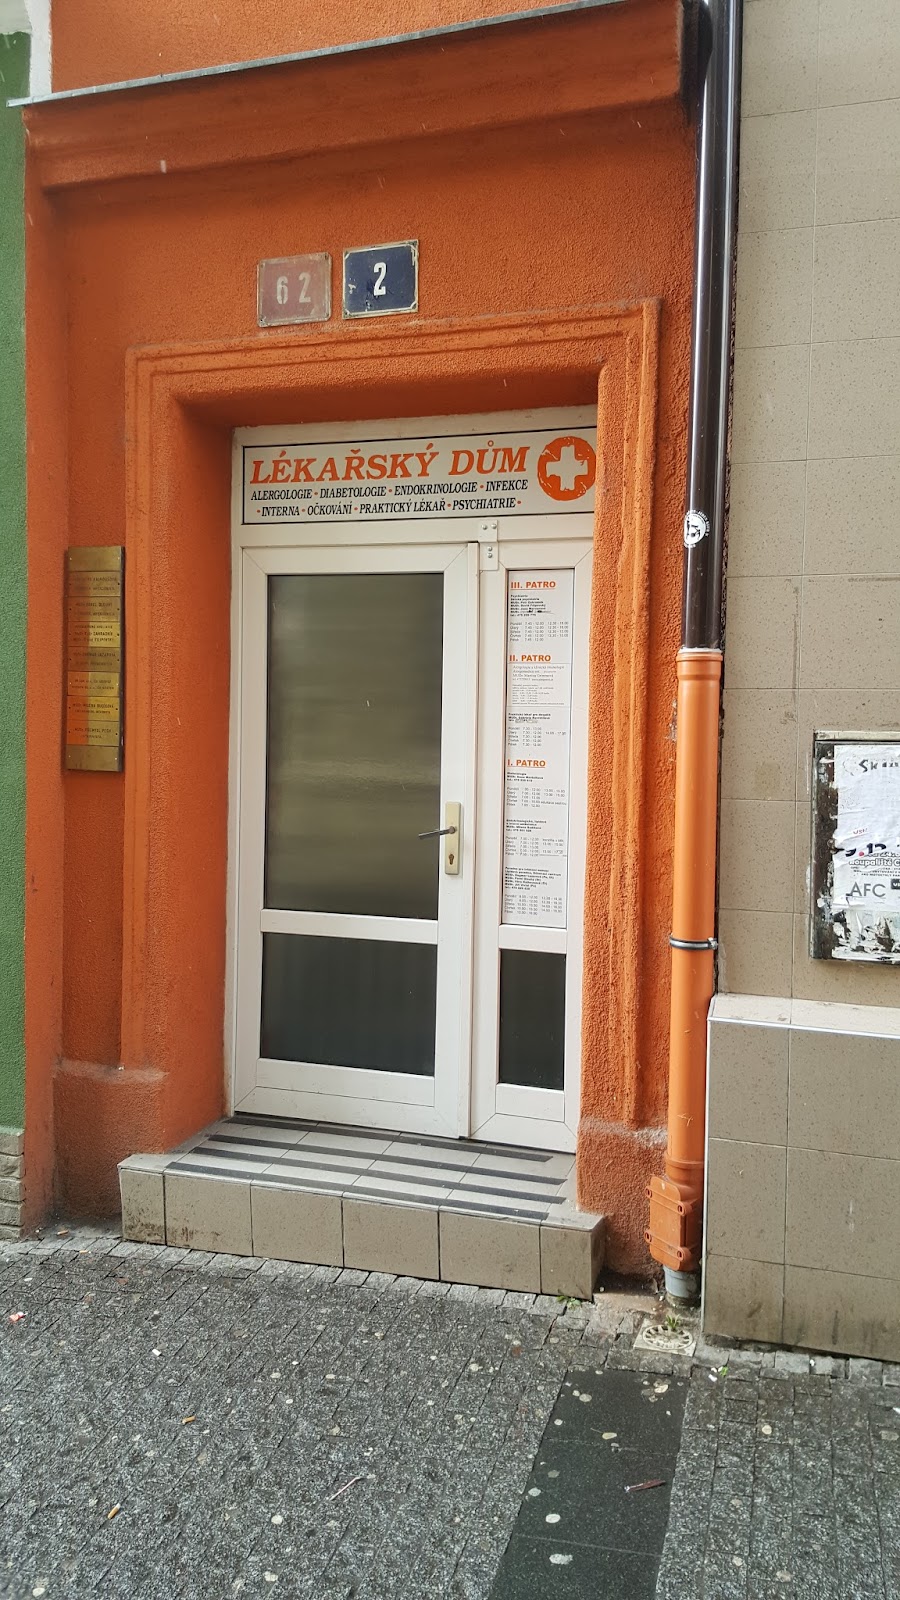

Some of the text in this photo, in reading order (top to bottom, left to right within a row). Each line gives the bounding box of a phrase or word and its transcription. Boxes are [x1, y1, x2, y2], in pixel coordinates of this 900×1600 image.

[276, 271, 312, 305] 62
[373, 261, 387, 297] 2
[249, 439, 531, 485] LÉKAŘSKÝ DŮM
[250, 479, 529, 501] ALERGOLOGIE DIABETOLOGIE ENDOKRINOLOGIE INFEKCE
[261, 497, 516, 517] INTERNA OČKOVÁNÍ PRAKTICKÝ LÉKAŘ PSYCHIATRIE
[510, 581, 556, 589] III. PATRO
[509, 654, 552, 662] II. PATRO
[507, 759, 546, 767] I. PATRO
[850, 881, 886, 898] AFC
